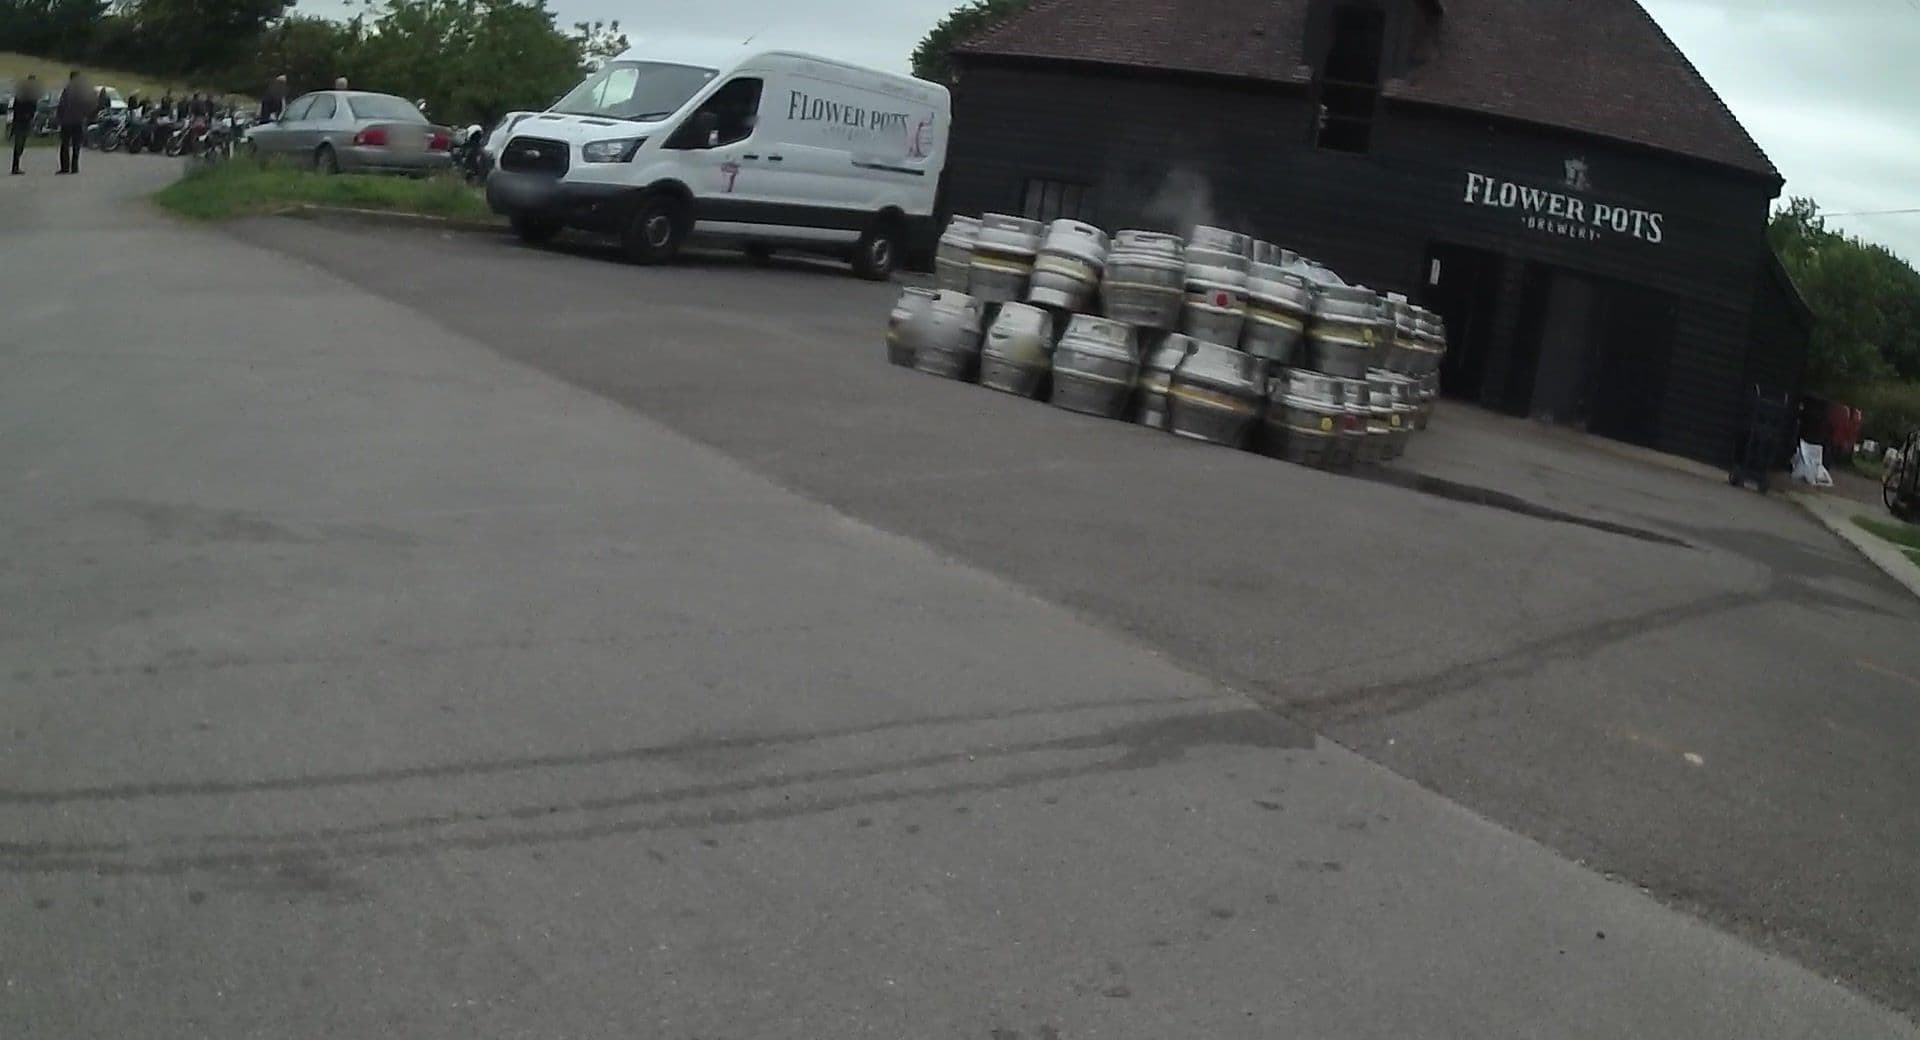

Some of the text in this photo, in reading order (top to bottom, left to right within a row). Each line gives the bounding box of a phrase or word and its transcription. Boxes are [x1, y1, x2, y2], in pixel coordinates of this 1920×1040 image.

[787, 89, 865, 128] FLOWER
[1463, 171, 1664, 244] FLOWER POTS
